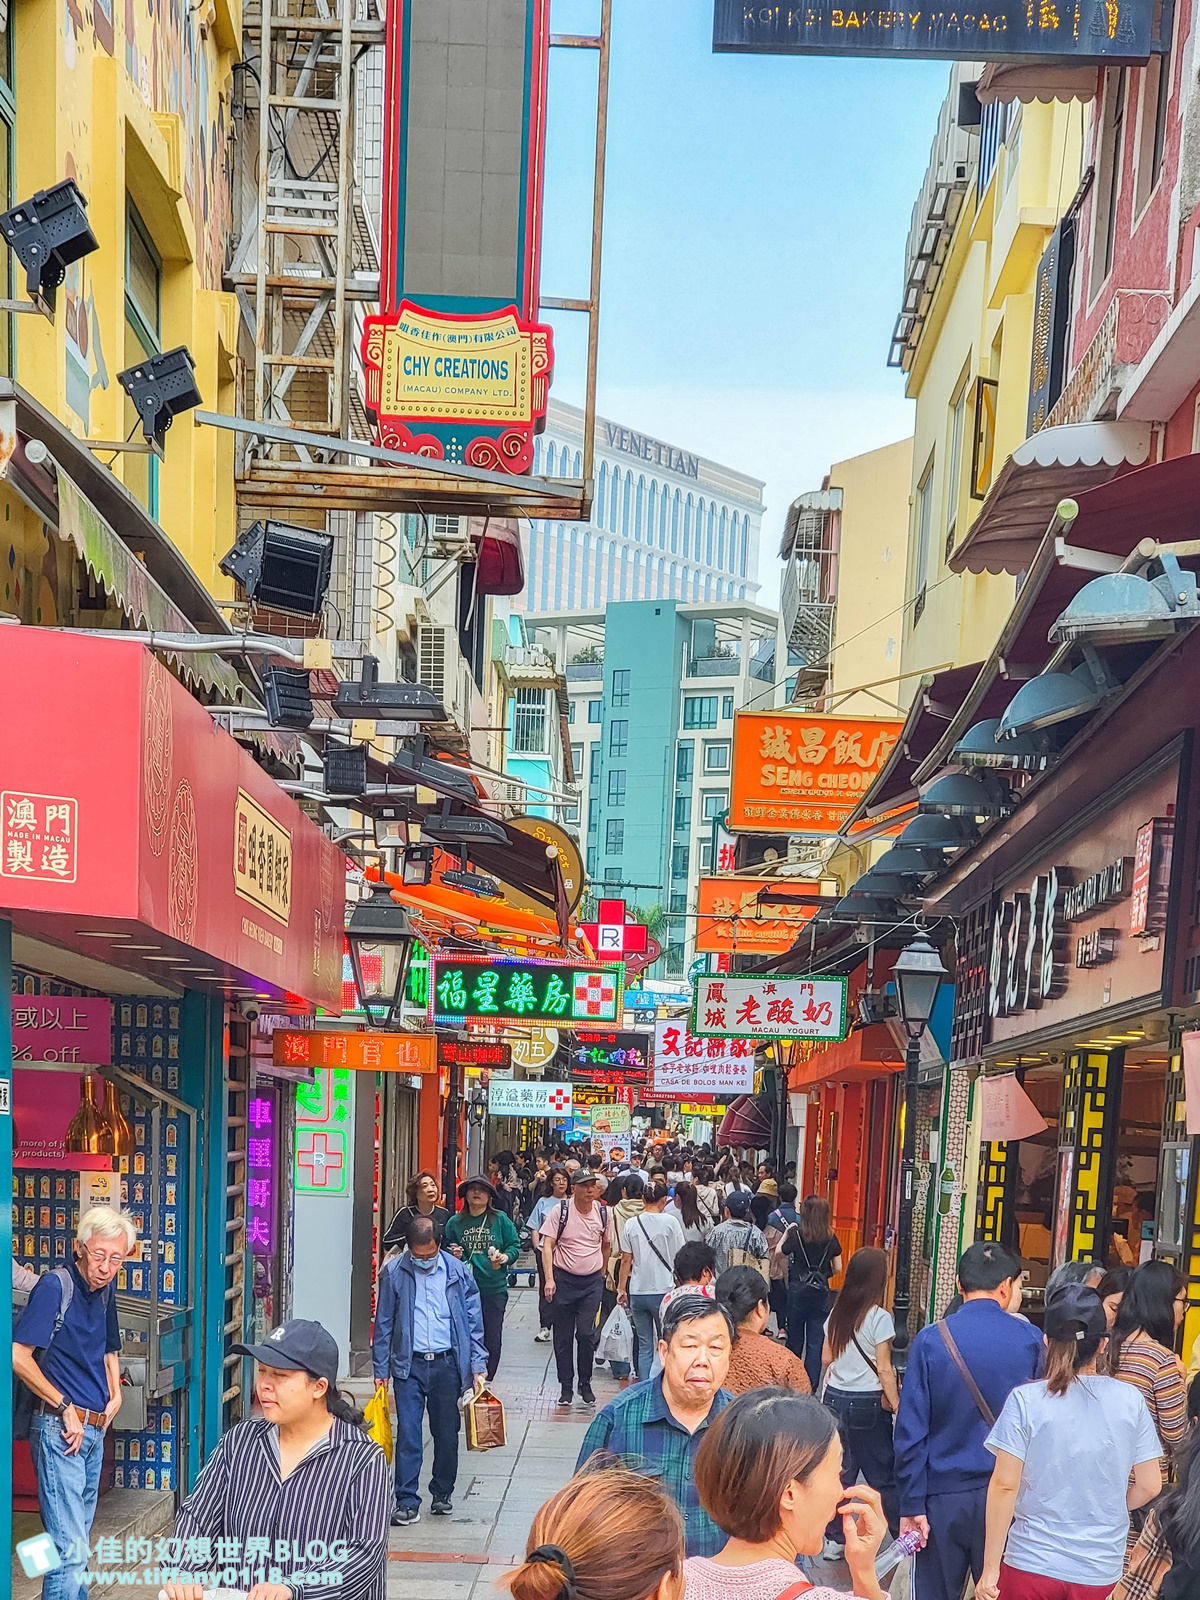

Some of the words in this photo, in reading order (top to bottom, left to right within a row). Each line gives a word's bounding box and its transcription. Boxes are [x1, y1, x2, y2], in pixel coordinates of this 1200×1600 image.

[831, 9, 921, 30] BAKERY
[403, 355, 431, 377] CHY
[434, 357, 509, 381] CREATIONS
[402, 384, 442, 394] (MACAU)
[444, 387, 489, 396] COMPANY
[492, 389, 513, 397] LTD.
[605, 421, 700, 480] VENETIAN
[759, 725, 898, 768] 誠昌飯店
[760, 764, 813, 787] SENG
[817, 773, 876, 790] CHEON
[6, 797, 71, 836] 澳門
[7, 831, 29, 839] MADE
[43, 834, 71, 843] MACAU
[6, 839, 72, 877] 製造
[437, 969, 571, 1014] 福星藥房
[762, 981, 814, 997] 澳門
[12, 1006, 88, 1030] 或以上
[736, 998, 833, 1026] 老酸奶
[284, 1034, 422, 1068] 澳門官也
[513, 1041, 546, 1061] 初五
[20, 1140, 46, 1148] more)
[48, 1140, 57, 1148] of
[22, 1150, 67, 1158] products).
[464, 1226, 491, 1236] adidas
[270, 1328, 285, 1340] R
